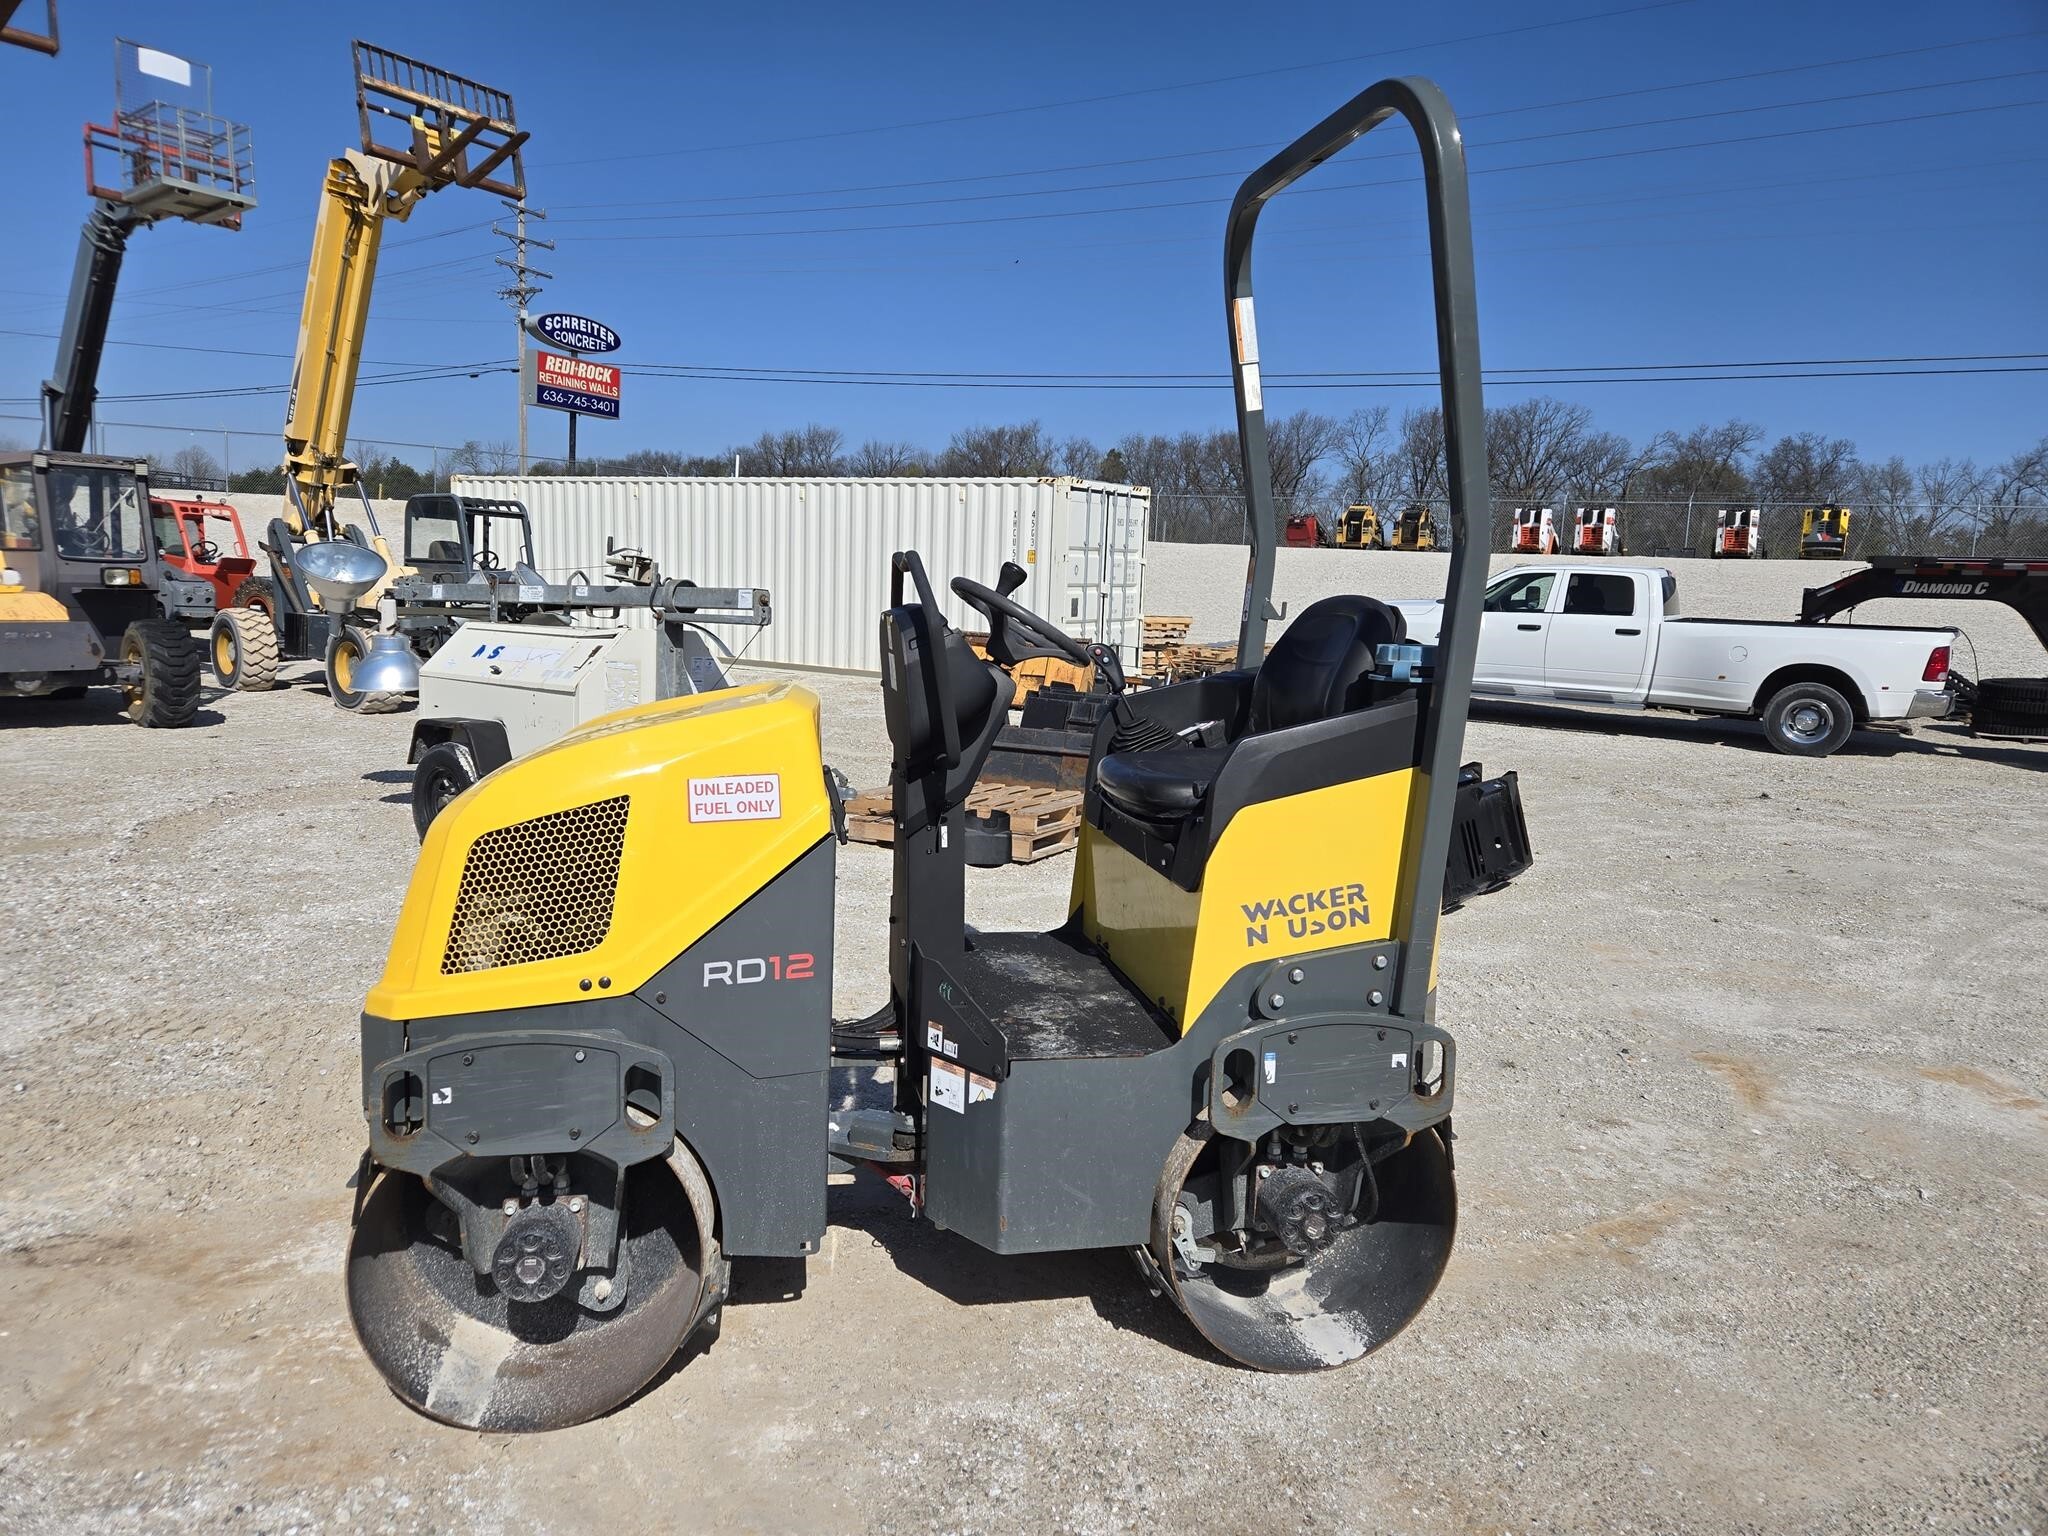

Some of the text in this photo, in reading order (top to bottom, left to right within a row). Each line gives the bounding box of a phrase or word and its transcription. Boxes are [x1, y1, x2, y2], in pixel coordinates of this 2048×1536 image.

[545, 315, 615, 347] SCHREITER
[554, 330, 607, 351] CONCRETE
[539, 371, 618, 397] RETAINING WALLS
[542, 390, 615, 412] 636-745-3401
[1902, 580, 1990, 595] DIAMOND C
[694, 781, 774, 796] UNLEADED
[695, 799, 775, 815] FUEL ONLY
[1240, 883, 1368, 923] WACKER
[703, 953, 815, 988] RD12
